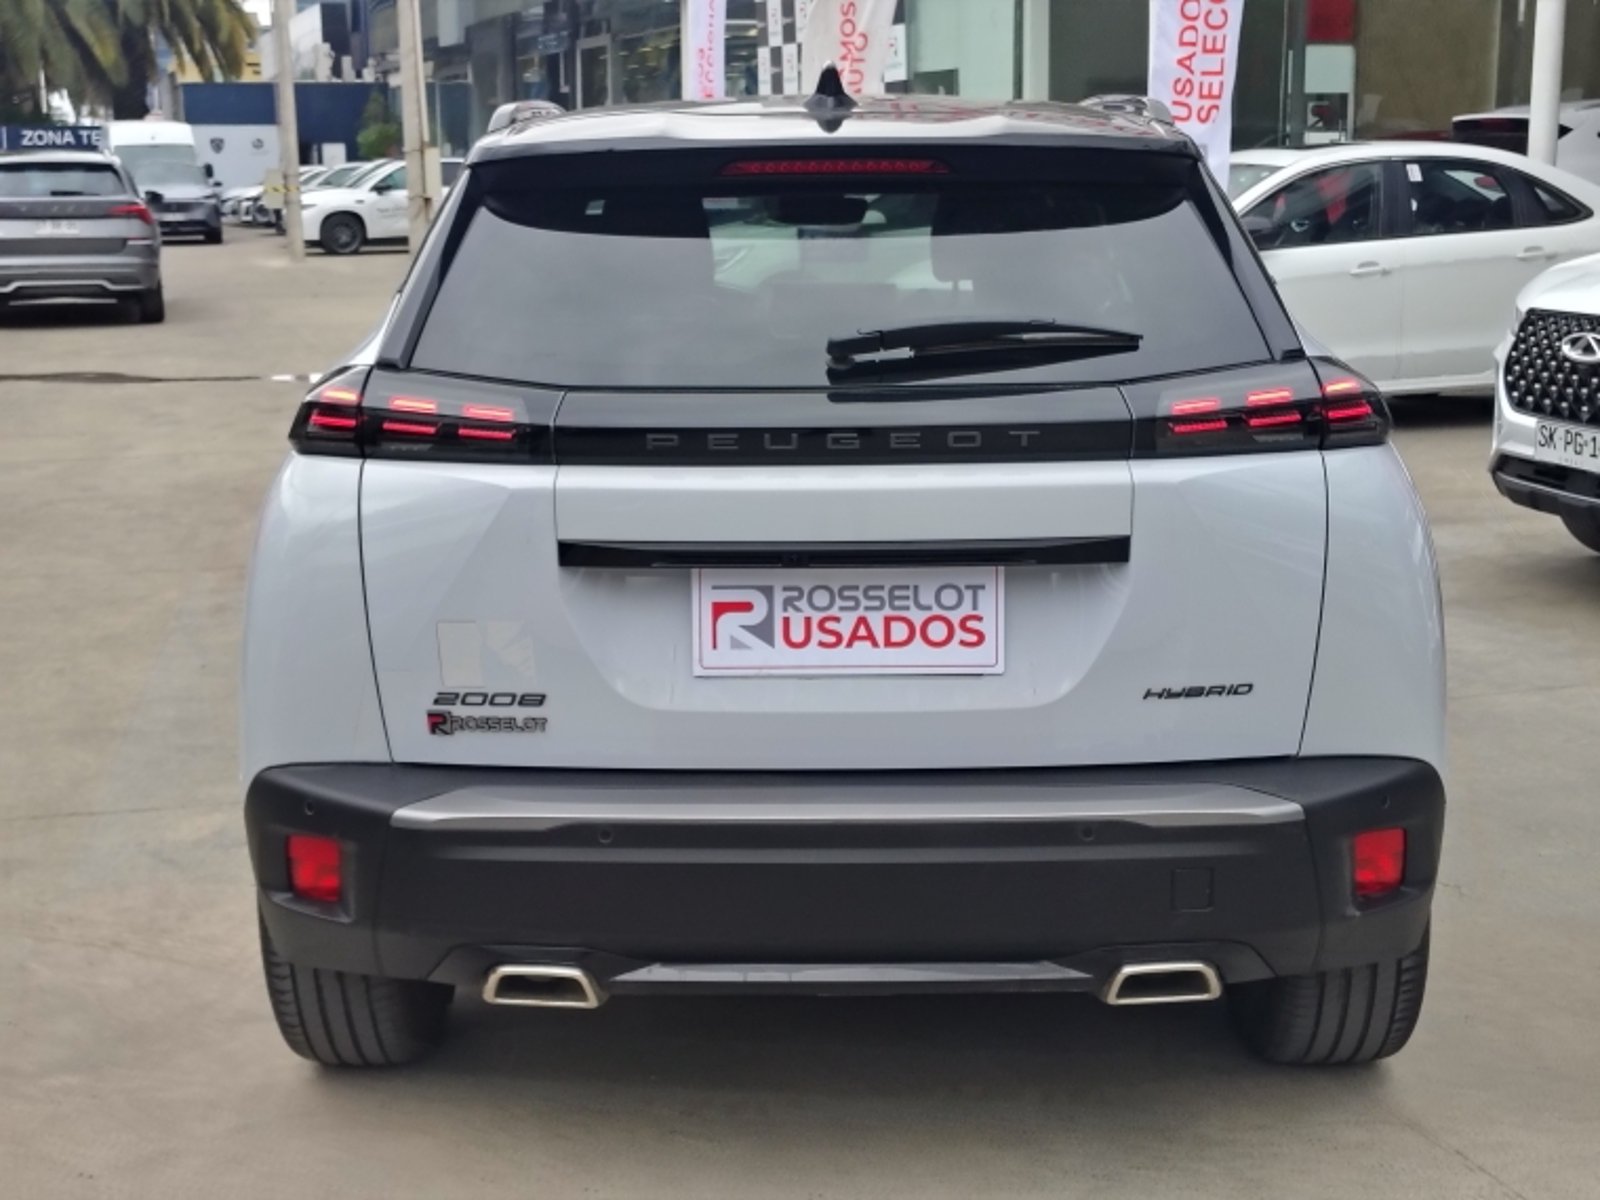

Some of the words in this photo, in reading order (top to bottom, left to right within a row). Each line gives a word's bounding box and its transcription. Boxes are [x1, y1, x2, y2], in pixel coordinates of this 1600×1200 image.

[1197, 0, 1228, 123] SELEC
[20, 129, 75, 146] ZONA
[646, 430, 1041, 451] PEUGEOT
[782, 583, 986, 613] ROSSELOT
[782, 614, 986, 649] USADOS
[433, 692, 547, 707] 2008
[1143, 683, 1254, 700] HYBRID
[453, 715, 548, 733] ROSSELOT
